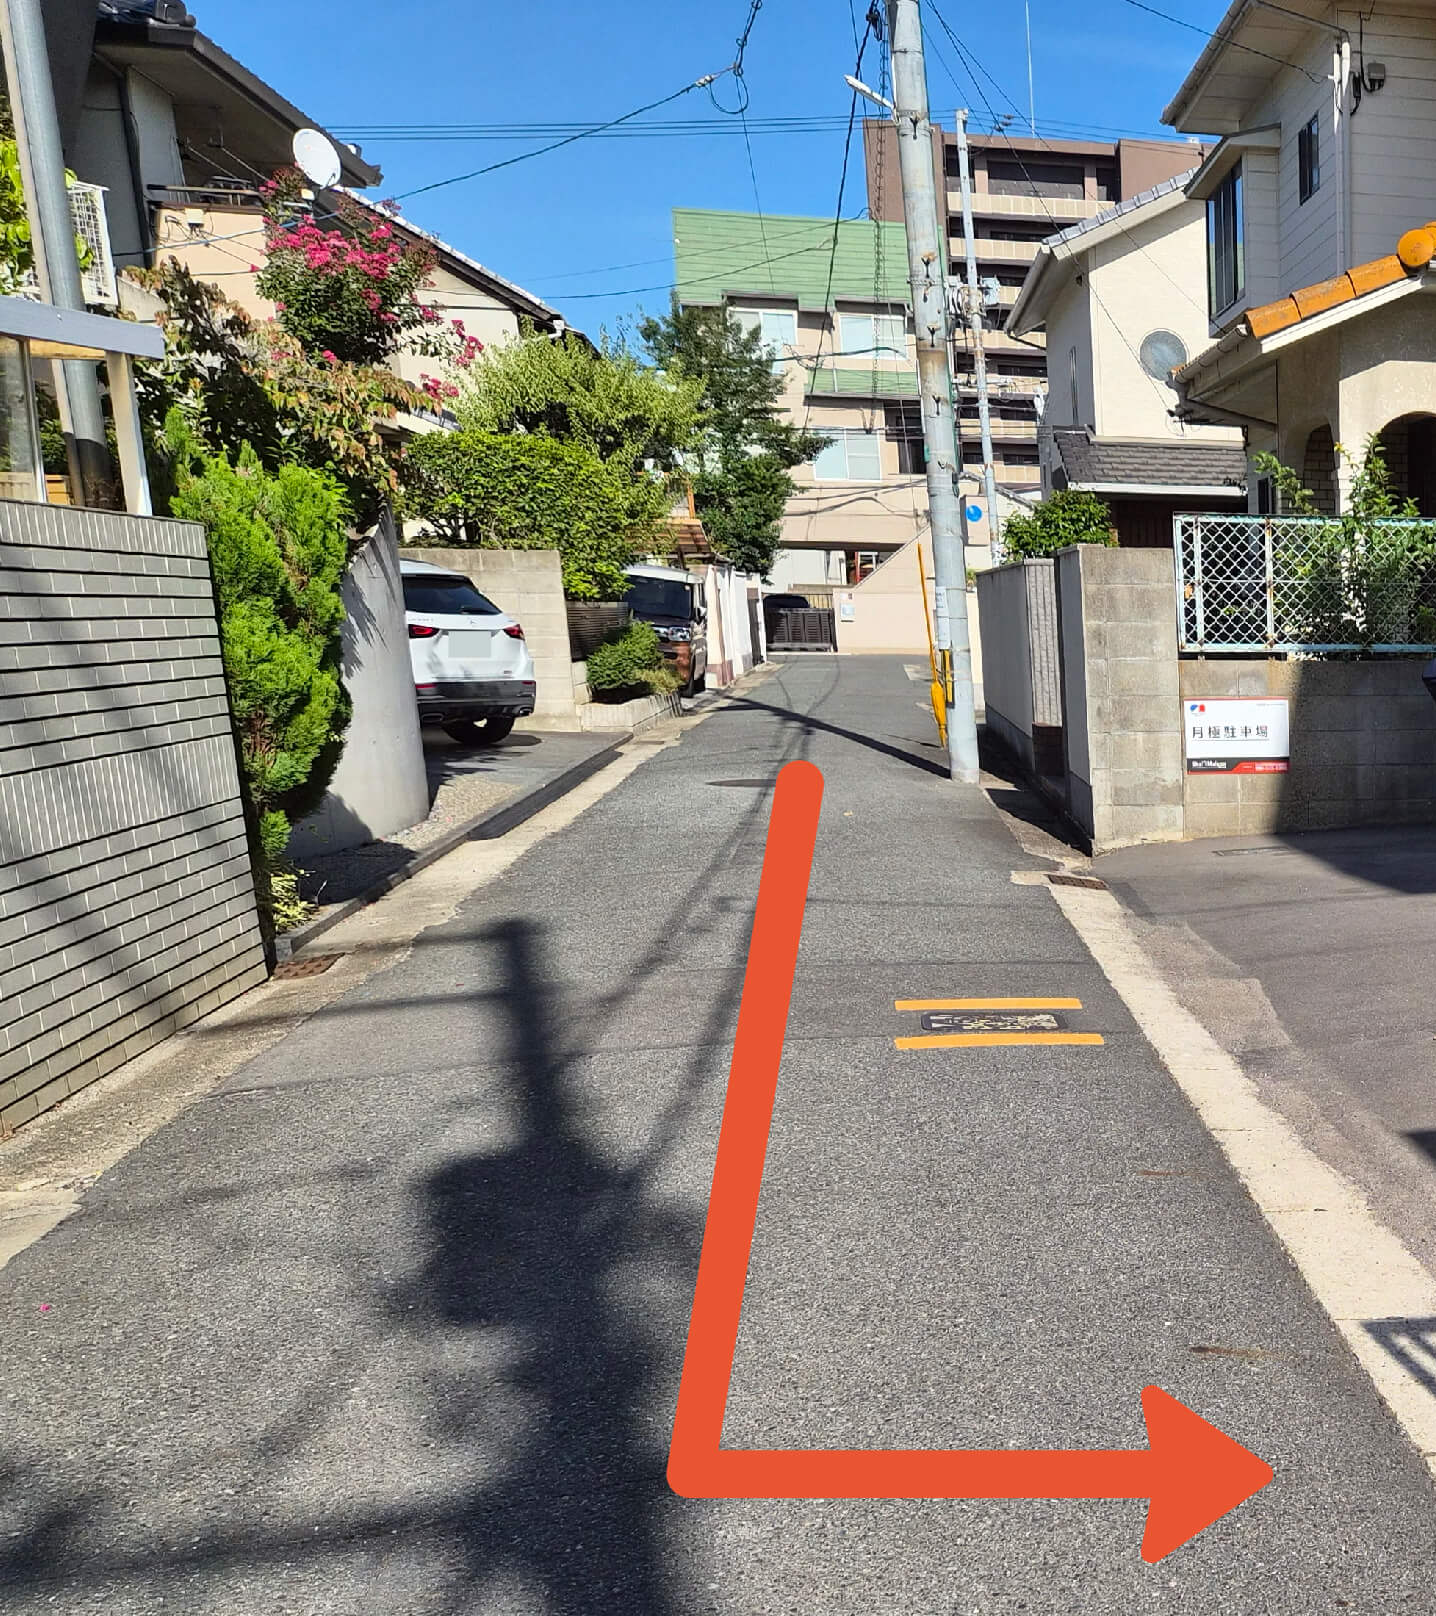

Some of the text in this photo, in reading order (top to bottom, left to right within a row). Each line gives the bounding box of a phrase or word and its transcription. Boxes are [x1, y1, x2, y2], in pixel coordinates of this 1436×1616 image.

[1192, 724, 1268, 738] 月極駐車場
